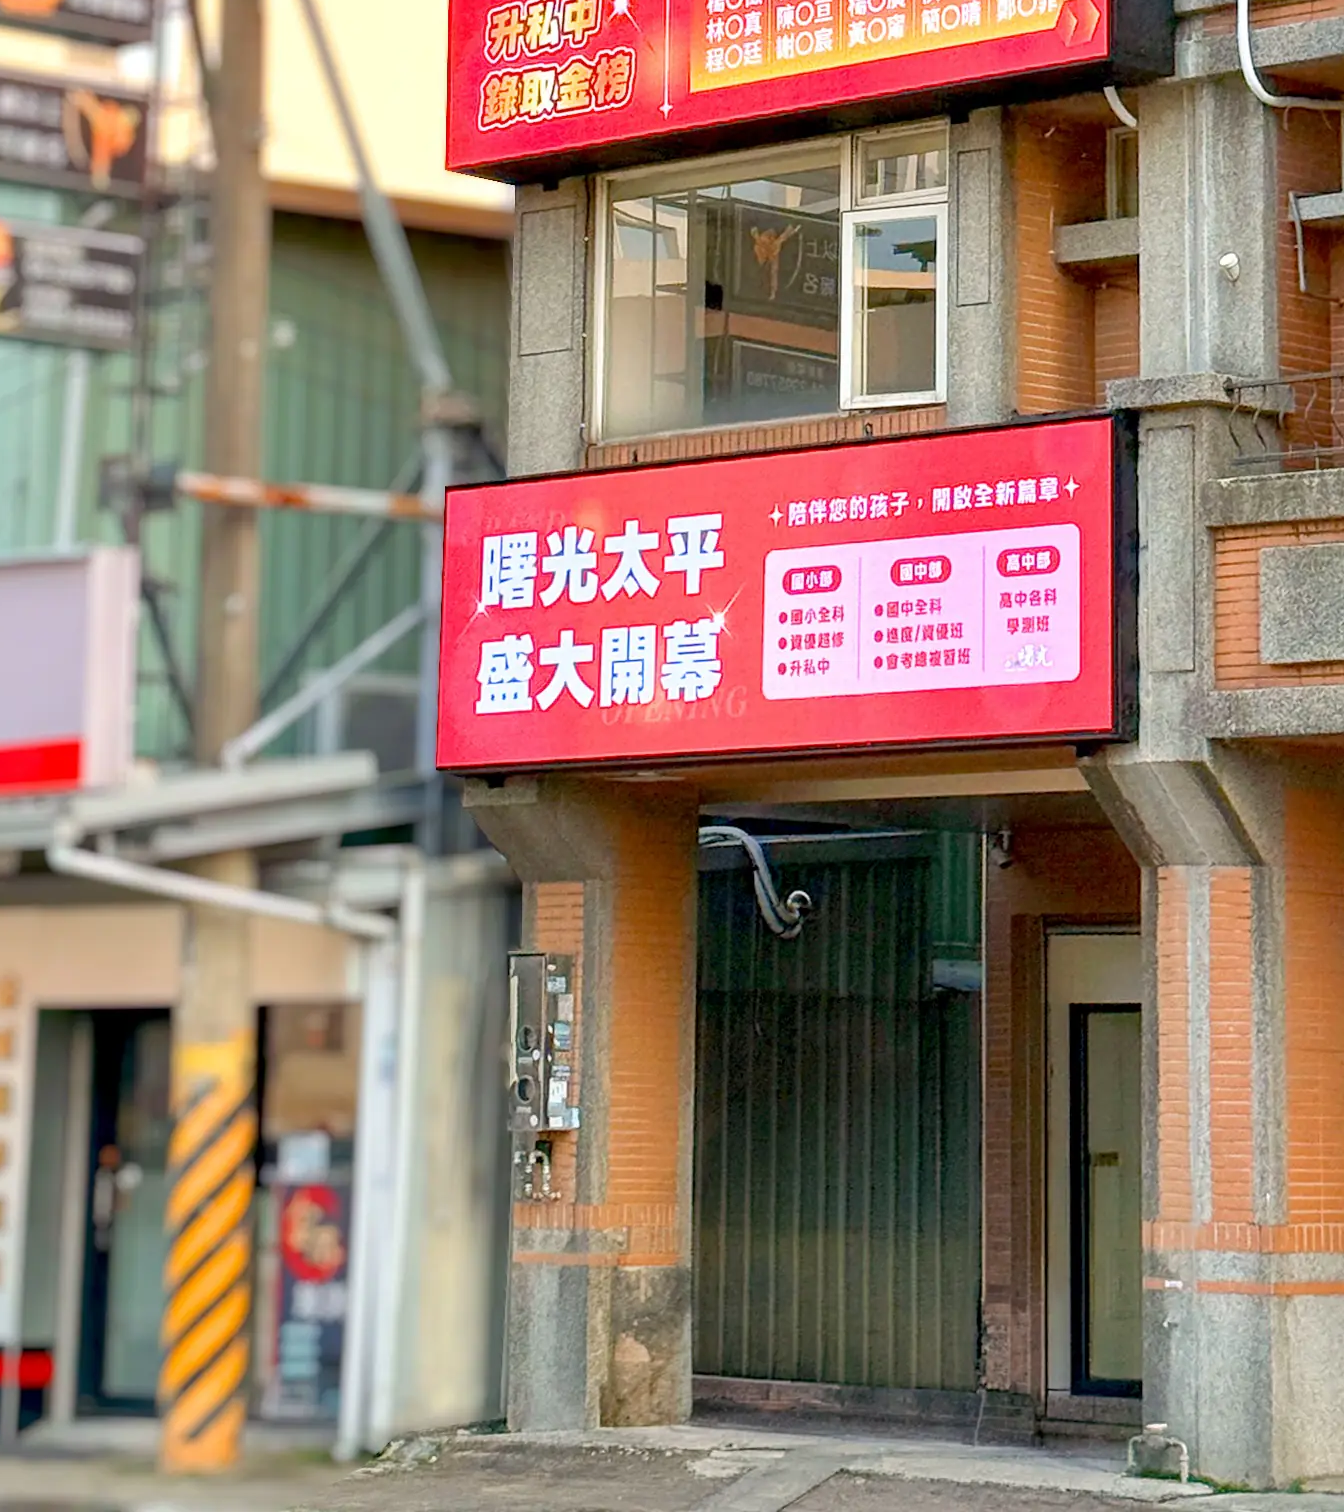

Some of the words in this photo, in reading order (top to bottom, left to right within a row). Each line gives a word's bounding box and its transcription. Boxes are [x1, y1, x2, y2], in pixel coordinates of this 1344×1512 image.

[480, 48, 634, 128] 錄取金榜
[481, 512, 725, 610] 曙光太平
[1006, 550, 1052, 573] 高中部
[790, 605, 844, 626] 國小全科
[886, 597, 942, 619] 國中全科
[999, 588, 1057, 609] 高中各科
[474, 618, 723, 715] 盛大開幕
[789, 657, 830, 678] 升私中
